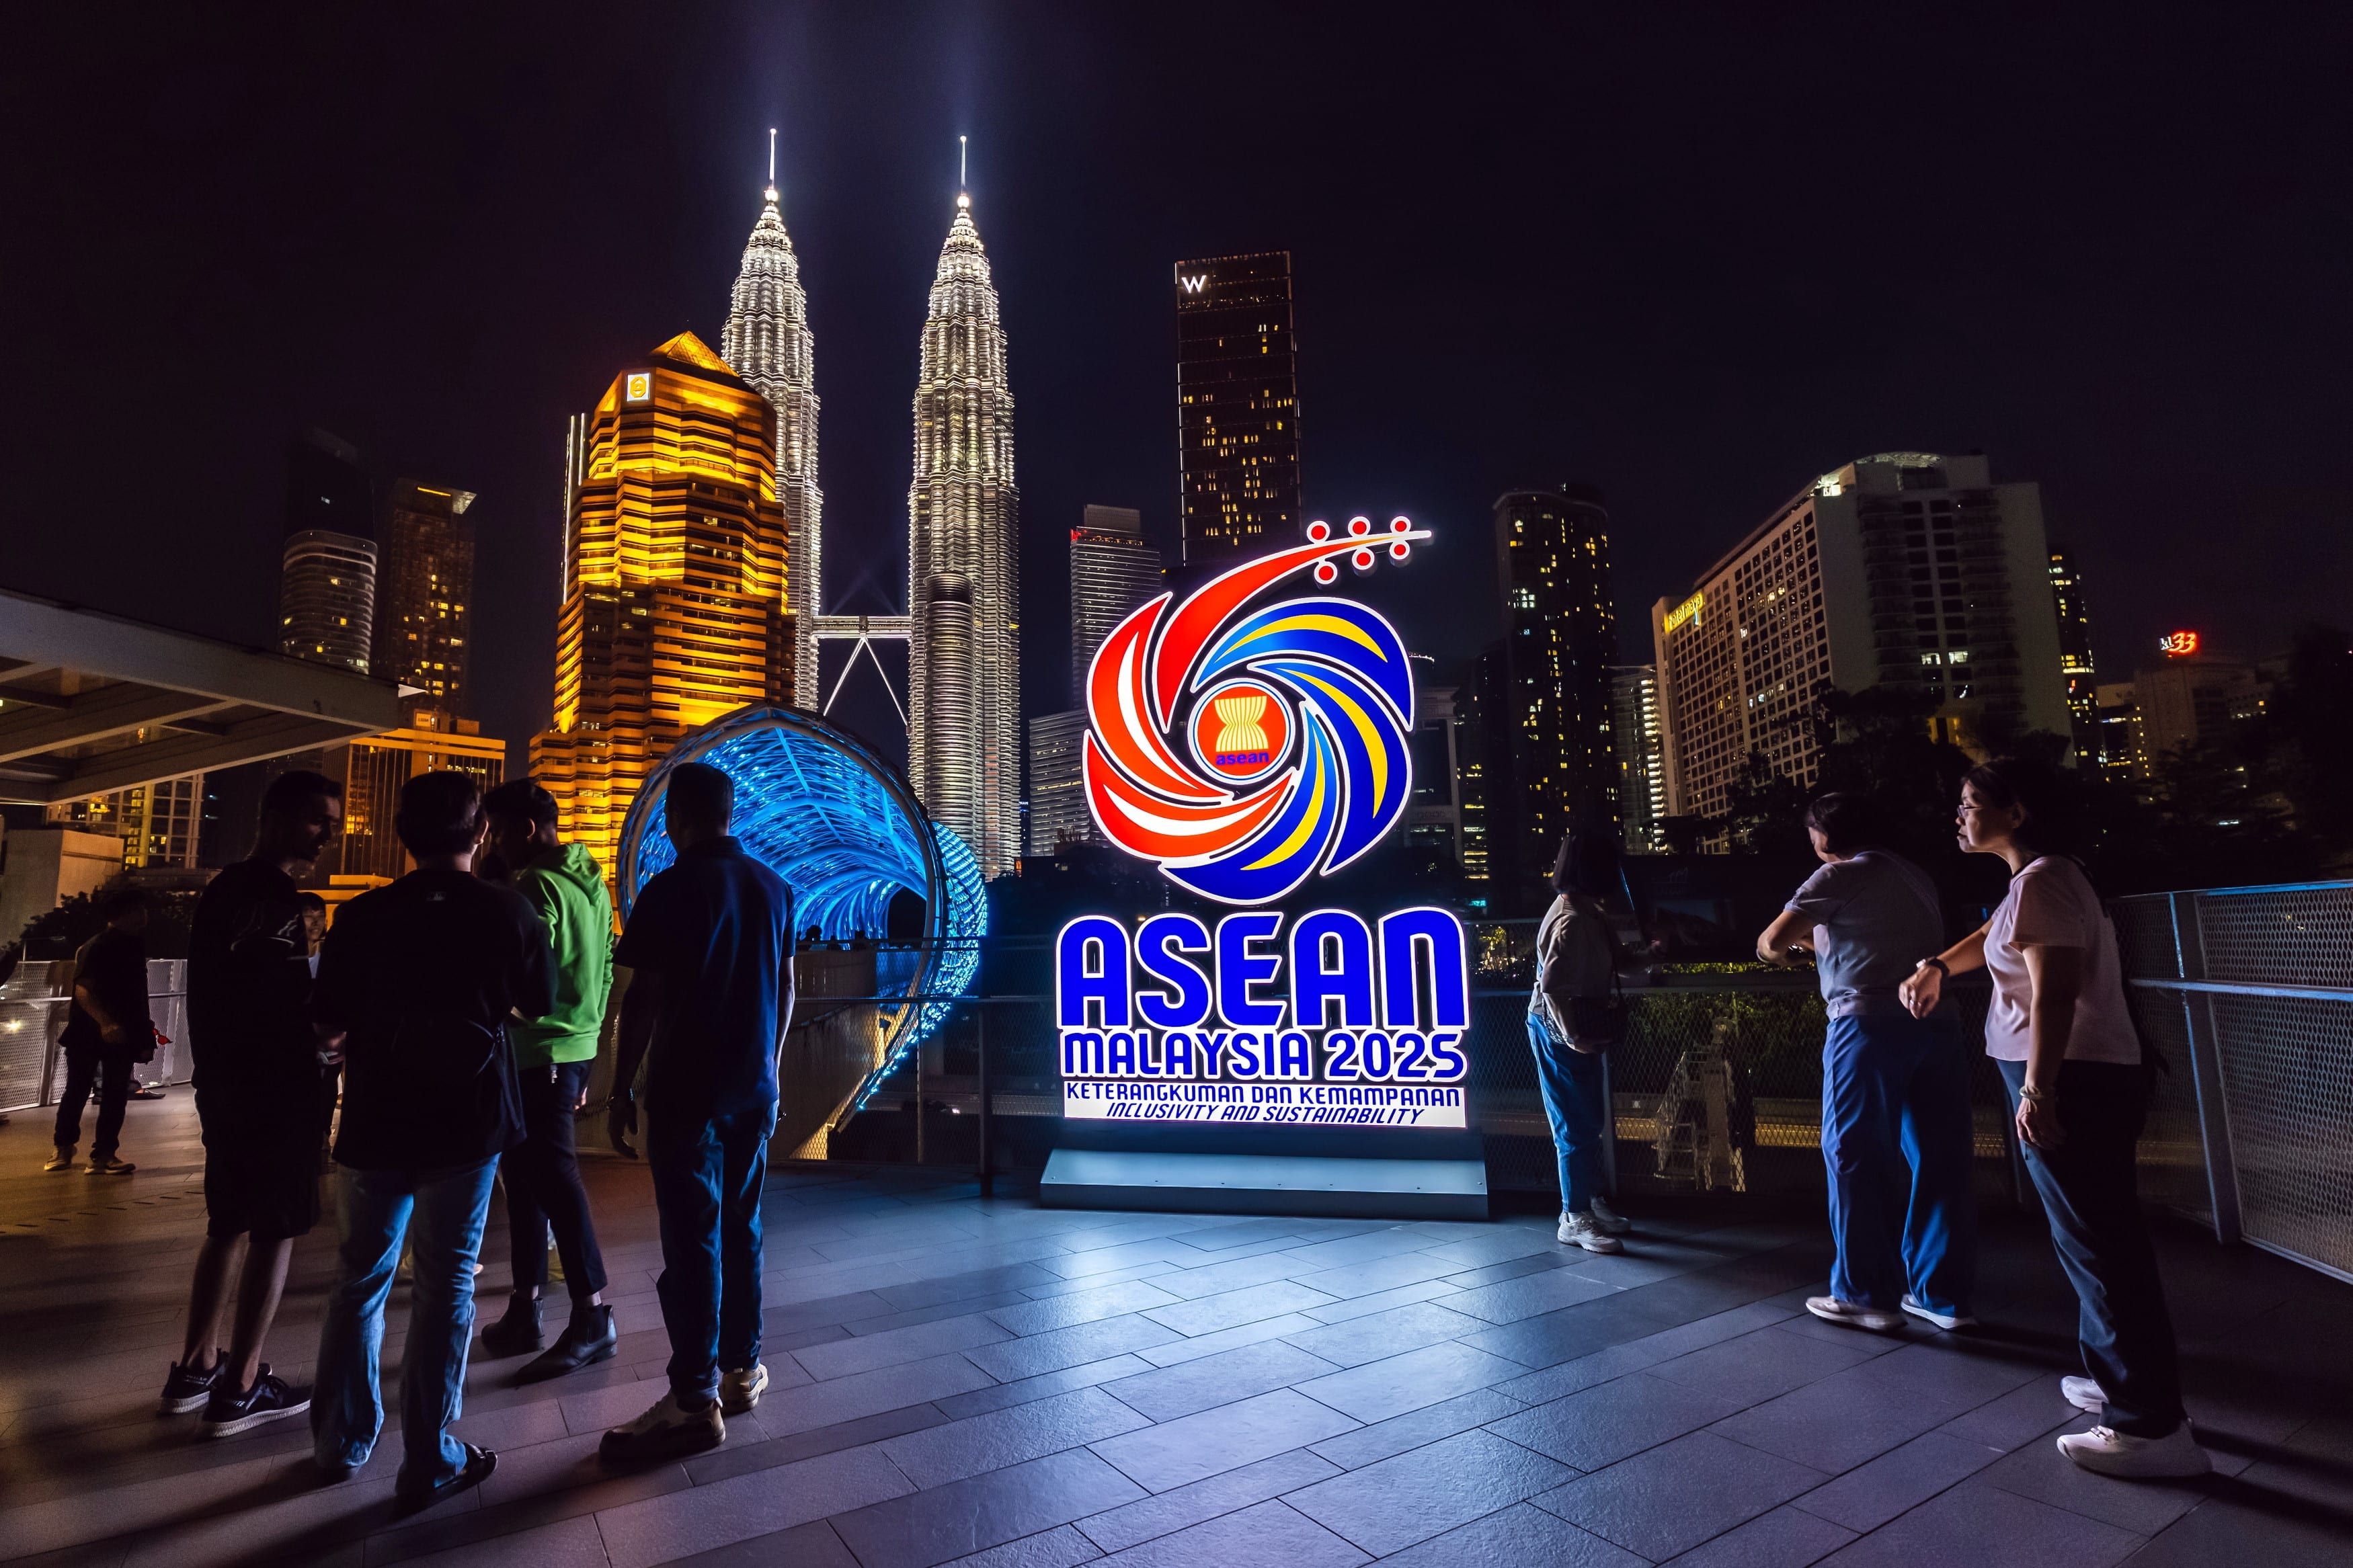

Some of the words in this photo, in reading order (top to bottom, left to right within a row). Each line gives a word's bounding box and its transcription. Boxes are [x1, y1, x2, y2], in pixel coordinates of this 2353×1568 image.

[1181, 275, 1207, 294] W
[1685, 595, 1701, 625] maya
[1215, 751, 1269, 766] asean
[1060, 909, 1466, 1028] ASEAN
[1064, 1032, 1309, 1076] MALAYSIA
[1327, 1032, 1464, 1078] 2025
[1066, 1082, 1244, 1103] KETERANGKUMAN
[1251, 1085, 1292, 1104] DAN
[1300, 1087, 1460, 1107] KEMAMPANAN
[1106, 1102, 1220, 1120] INCLUSIVITY
[1221, 1105, 1261, 1120] AND
[1263, 1106, 1425, 1124] SUSTAINABILITY
